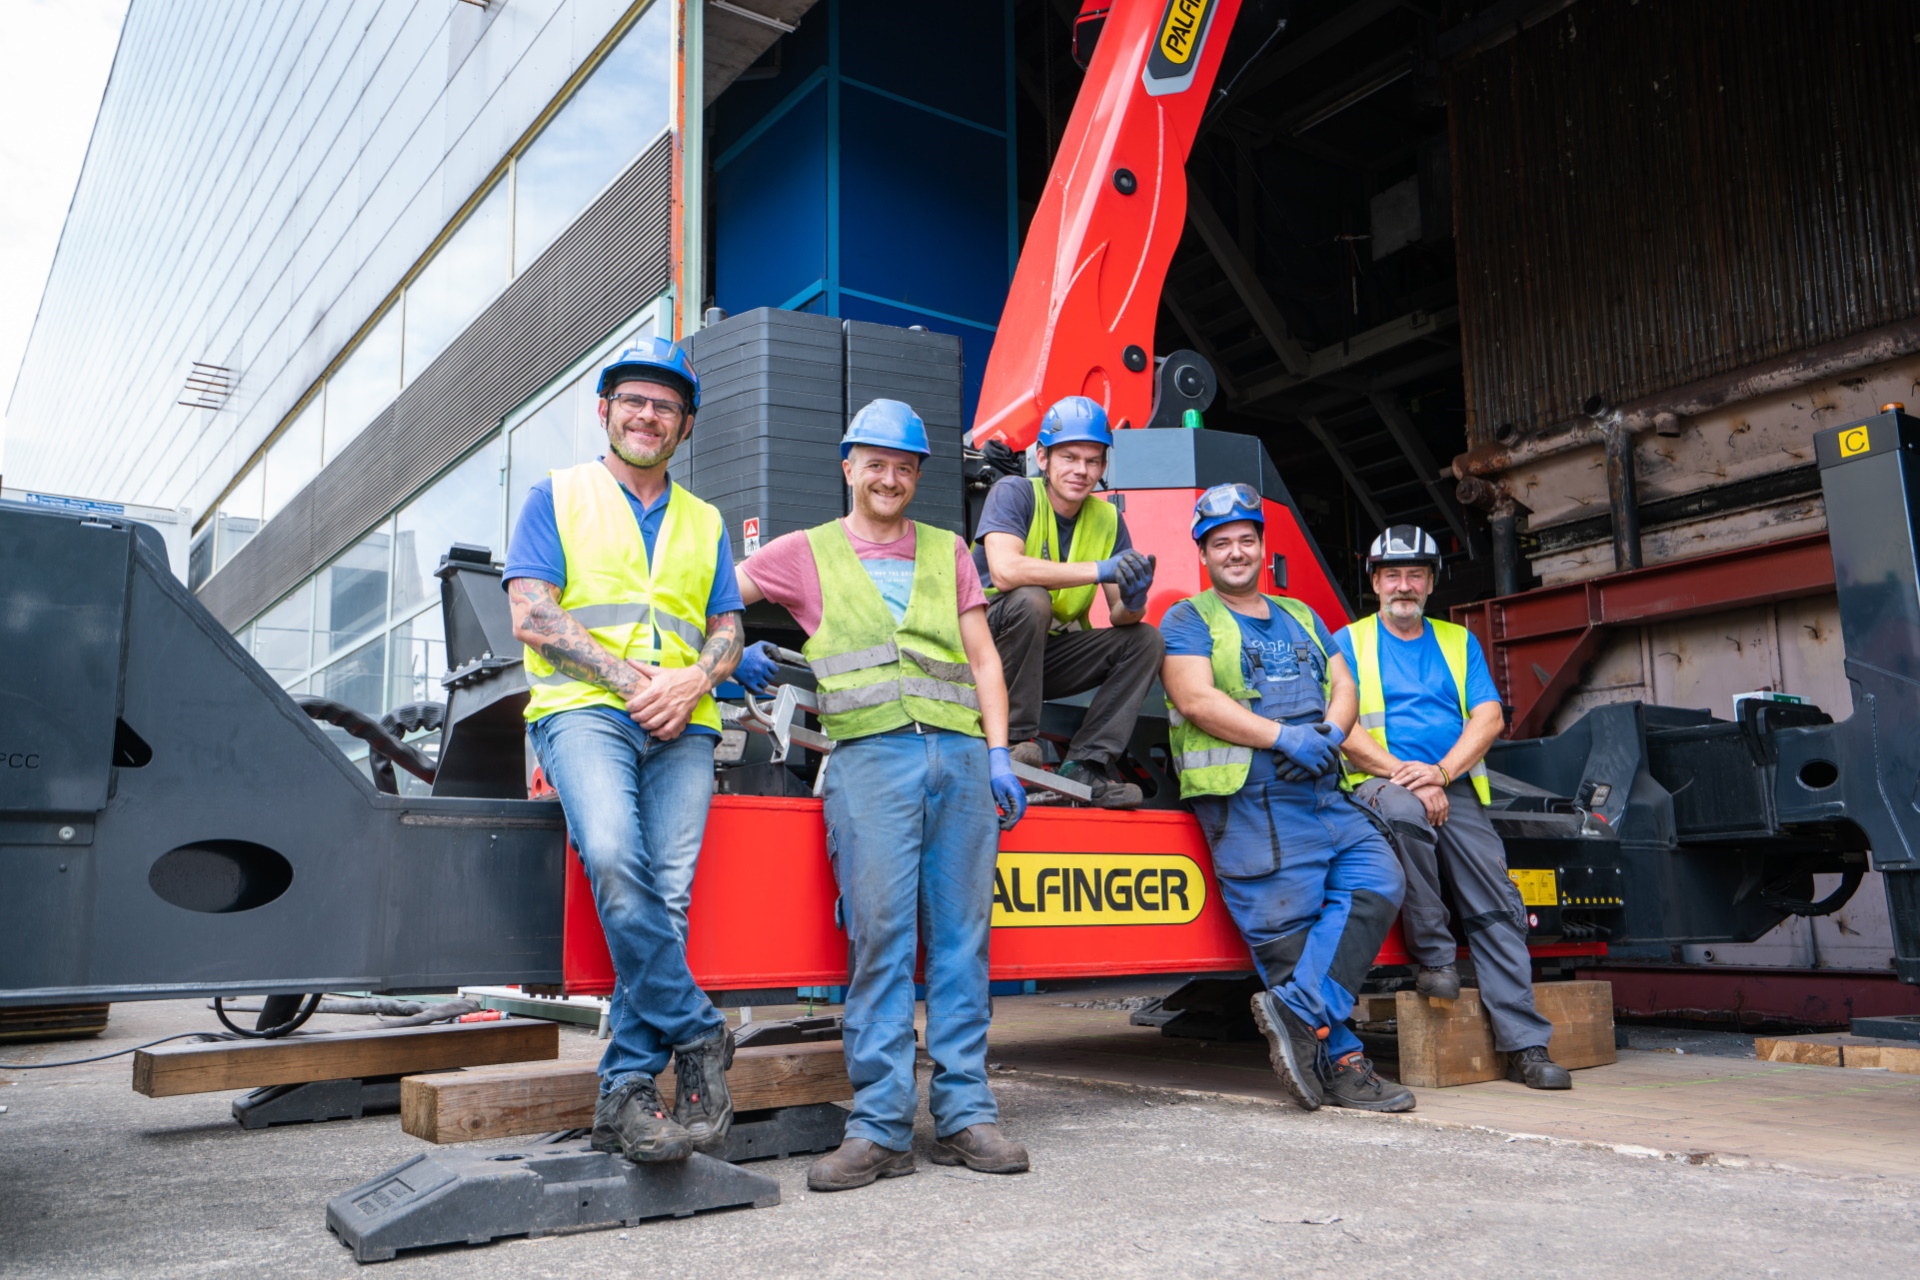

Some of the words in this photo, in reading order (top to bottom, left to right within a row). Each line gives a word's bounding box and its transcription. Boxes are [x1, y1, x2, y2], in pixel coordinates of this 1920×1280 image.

[1165, 0, 1202, 57] PALFI
[1845, 430, 1865, 452] C
[993, 867, 1190, 913] ALFINGER
